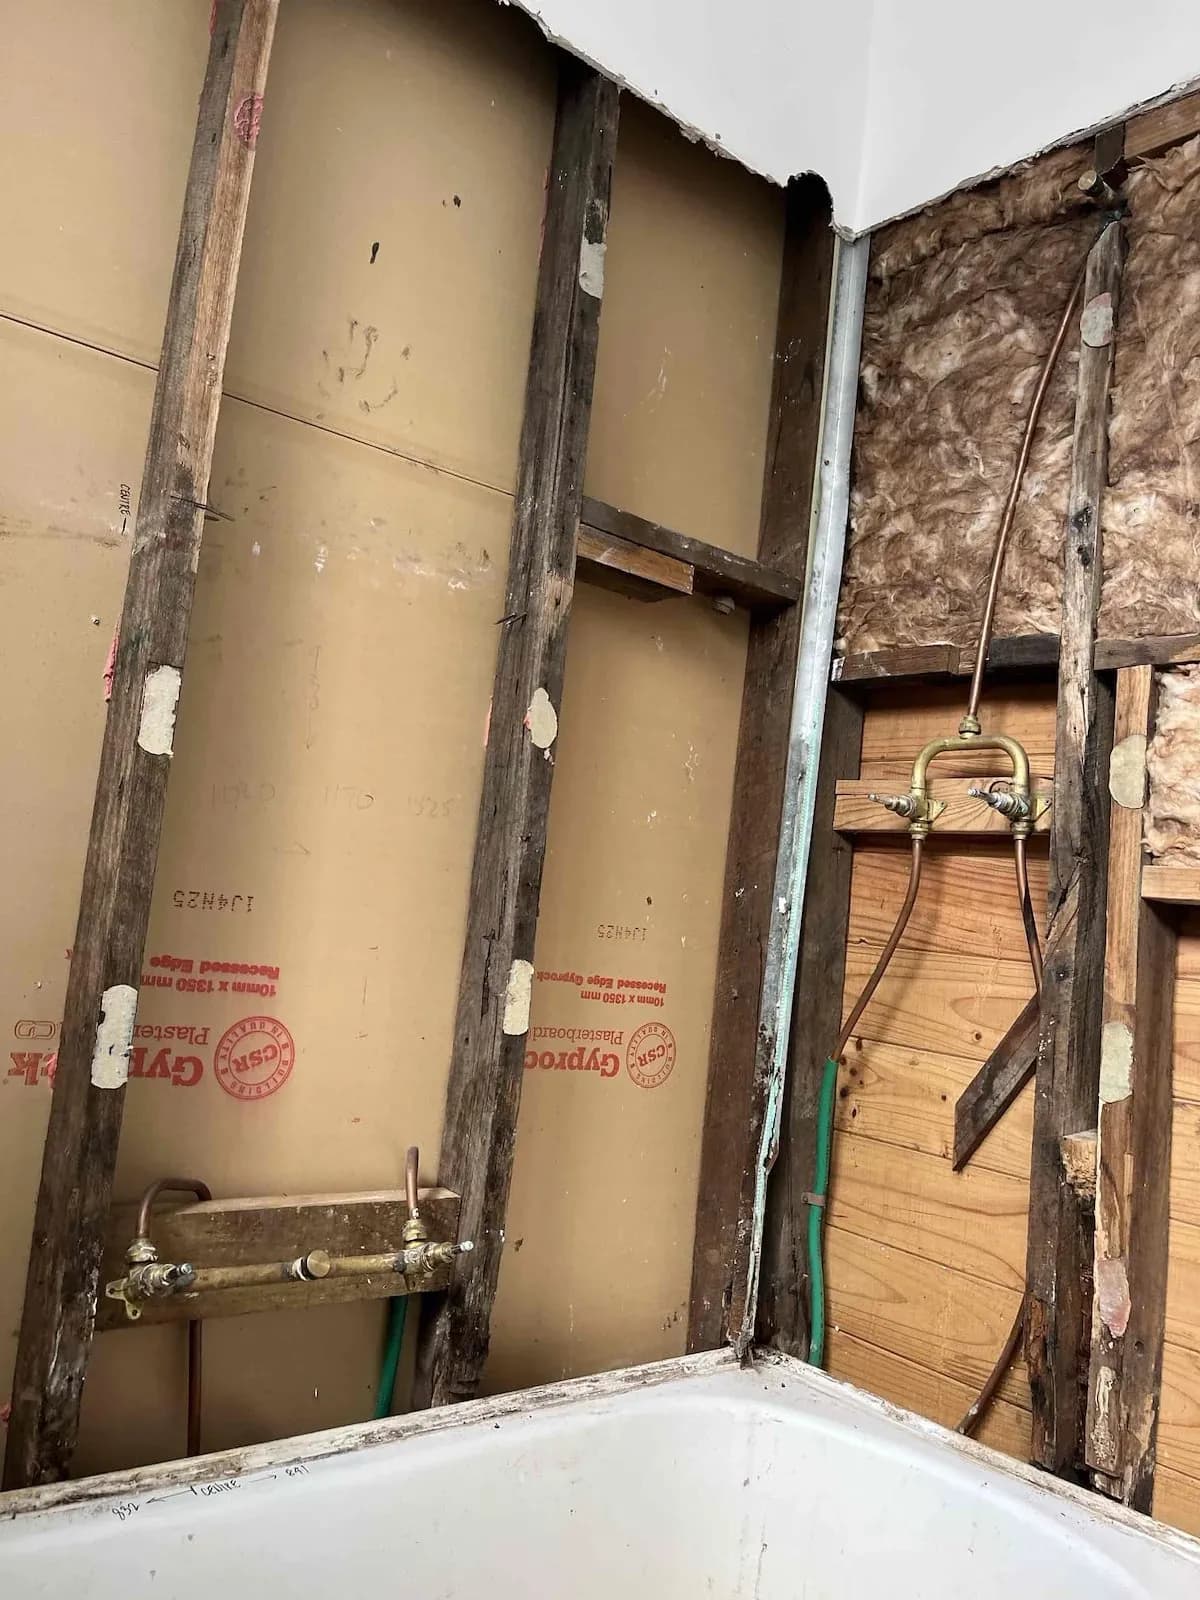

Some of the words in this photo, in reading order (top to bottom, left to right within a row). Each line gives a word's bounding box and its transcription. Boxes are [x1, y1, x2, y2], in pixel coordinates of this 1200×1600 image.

[149, 955, 194, 974] Edge
[199, 960, 280, 980] Recessed
[175, 978, 215, 993] 1350
[536, 971, 584, 986] Gyprock
[587, 976, 614, 989] Edge
[617, 979, 667, 993] Recessed
[218, 981, 229, 992] x
[231, 982, 277, 997] 10mm
[580, 991, 601, 1002] mm
[603, 992, 626, 1004] 1350
[628, 995, 636, 1003] x
[637, 995, 665, 1007] 10mm
[532, 1026, 624, 1046] Plasterboard
[231, 1044, 278, 1073] CSR
[524, 1048, 620, 1078] Gyproc
[636, 1044, 666, 1067] CSR
